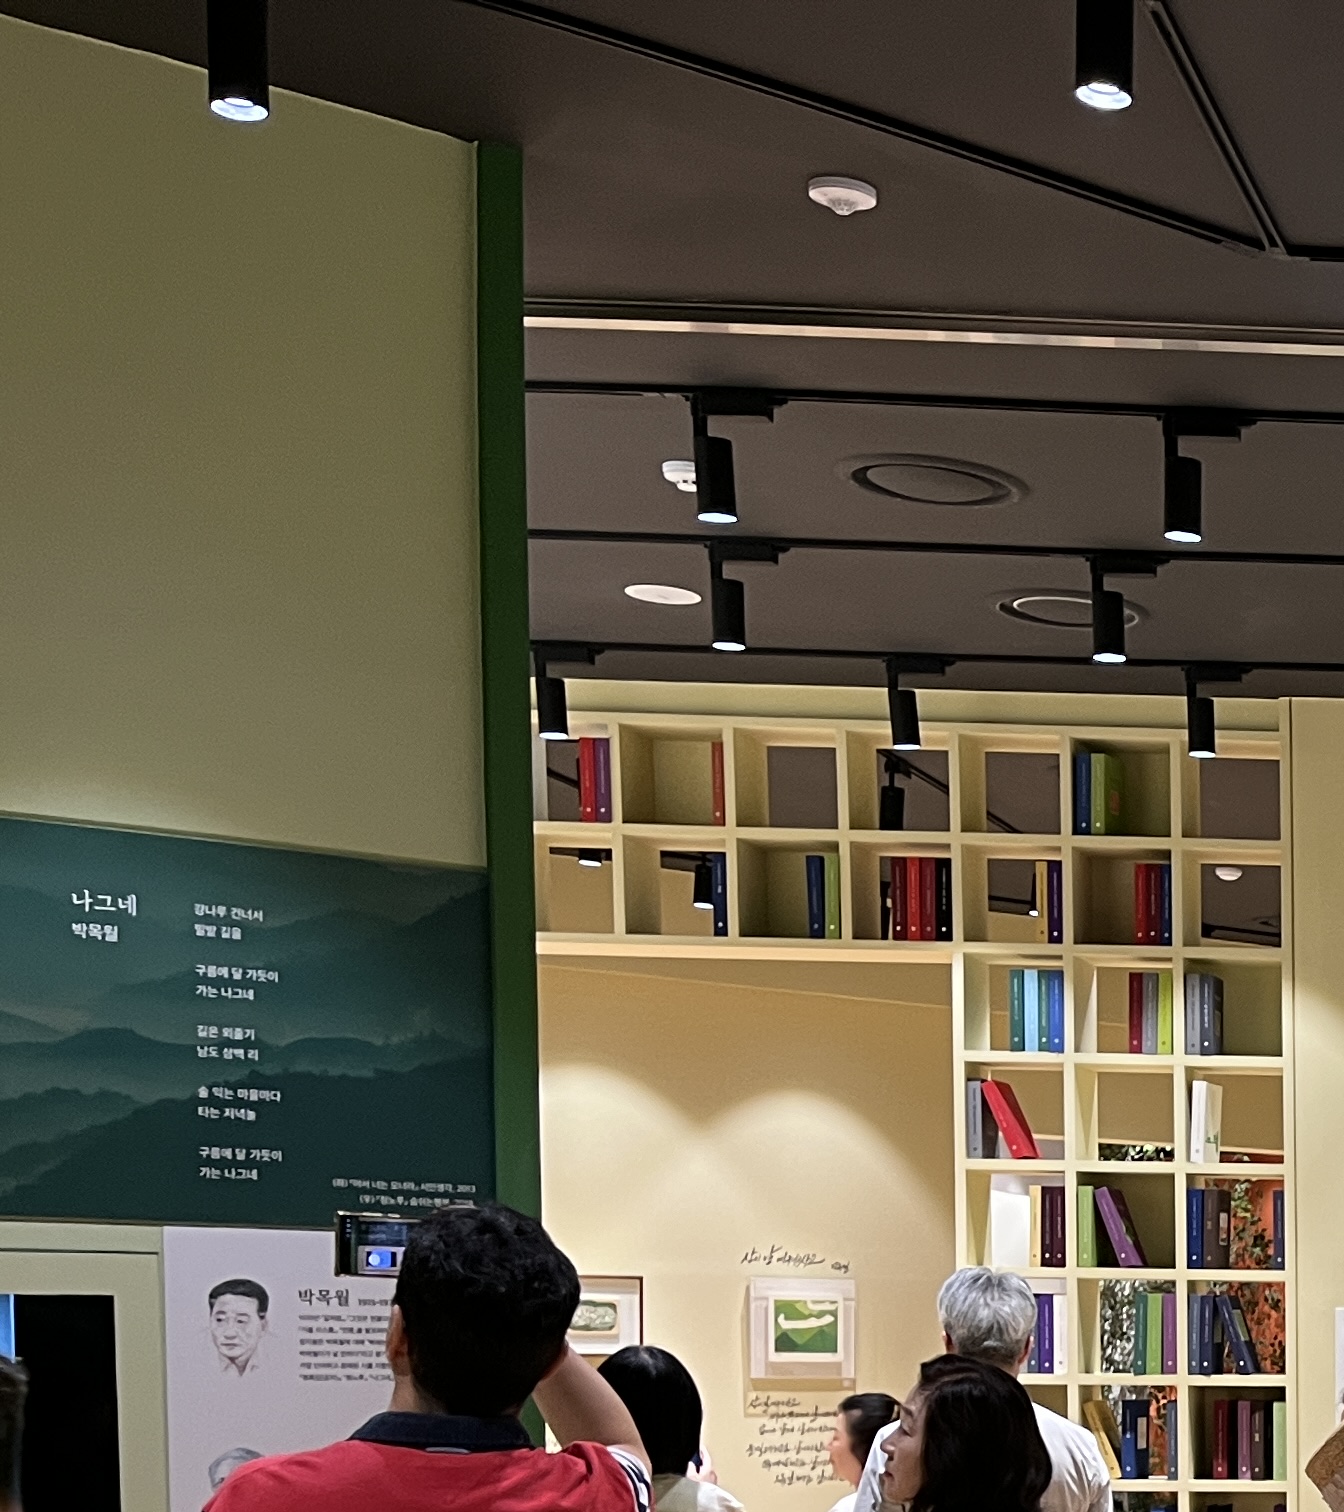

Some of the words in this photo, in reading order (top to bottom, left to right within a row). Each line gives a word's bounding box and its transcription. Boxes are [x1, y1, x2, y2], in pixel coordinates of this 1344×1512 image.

[71, 889, 137, 917] 나그네
[72, 922, 119, 943] 박목월
[195, 964, 229, 979] 구름에
[245, 968, 279, 983] 가듯이
[195, 985, 218, 998] 가는
[221, 987, 255, 1000] 나그네
[249, 1149, 283, 1162] 가듯이
[199, 1167, 221, 1179] 가는
[224, 1168, 258, 1180] 나그네
[298, 1289, 349, 1307] 박목월
